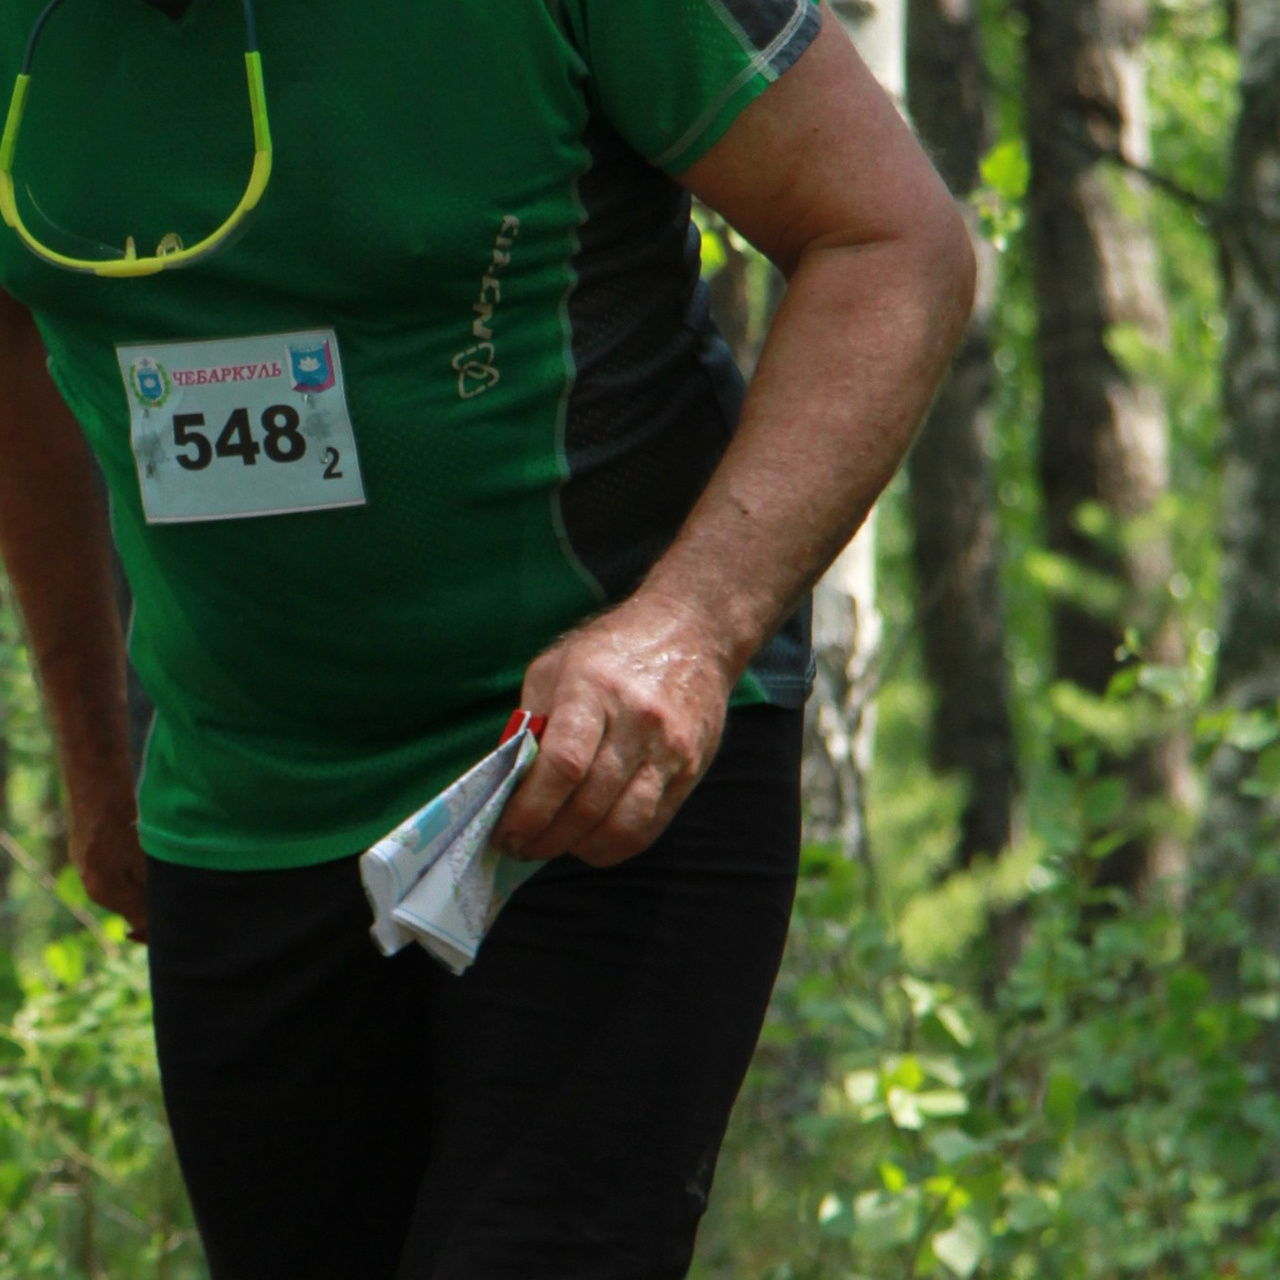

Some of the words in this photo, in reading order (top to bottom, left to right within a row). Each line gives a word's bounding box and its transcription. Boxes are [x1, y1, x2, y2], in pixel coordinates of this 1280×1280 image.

[172, 363, 282, 386] ЧЕБАРКУЛЬ
[172, 404, 306, 471] 548
[322, 447, 343, 480] 2
